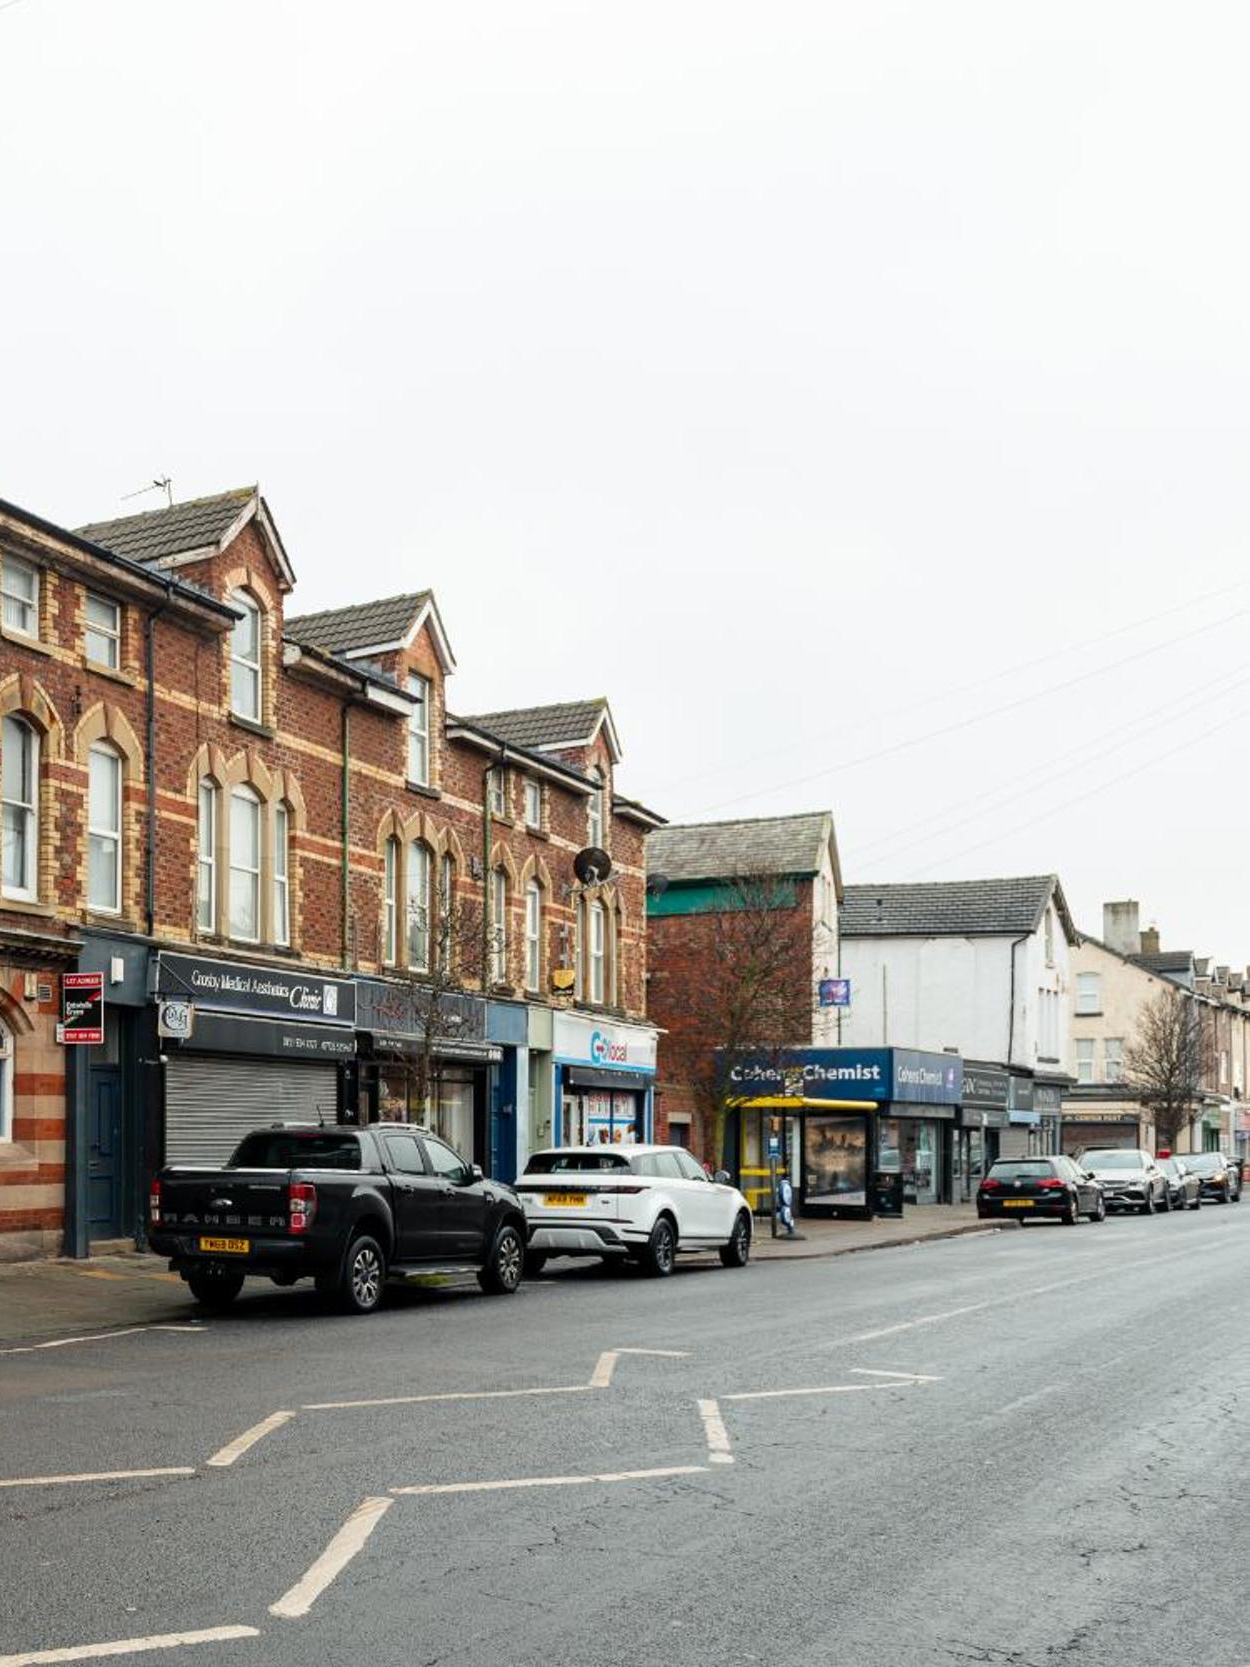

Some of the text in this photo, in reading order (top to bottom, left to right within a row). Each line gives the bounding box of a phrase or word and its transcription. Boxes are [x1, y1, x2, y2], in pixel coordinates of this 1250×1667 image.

[191, 970, 321, 1010] Crosby Medical Aesthetics Clinic
[803, 1064, 880, 1080] Chemist
